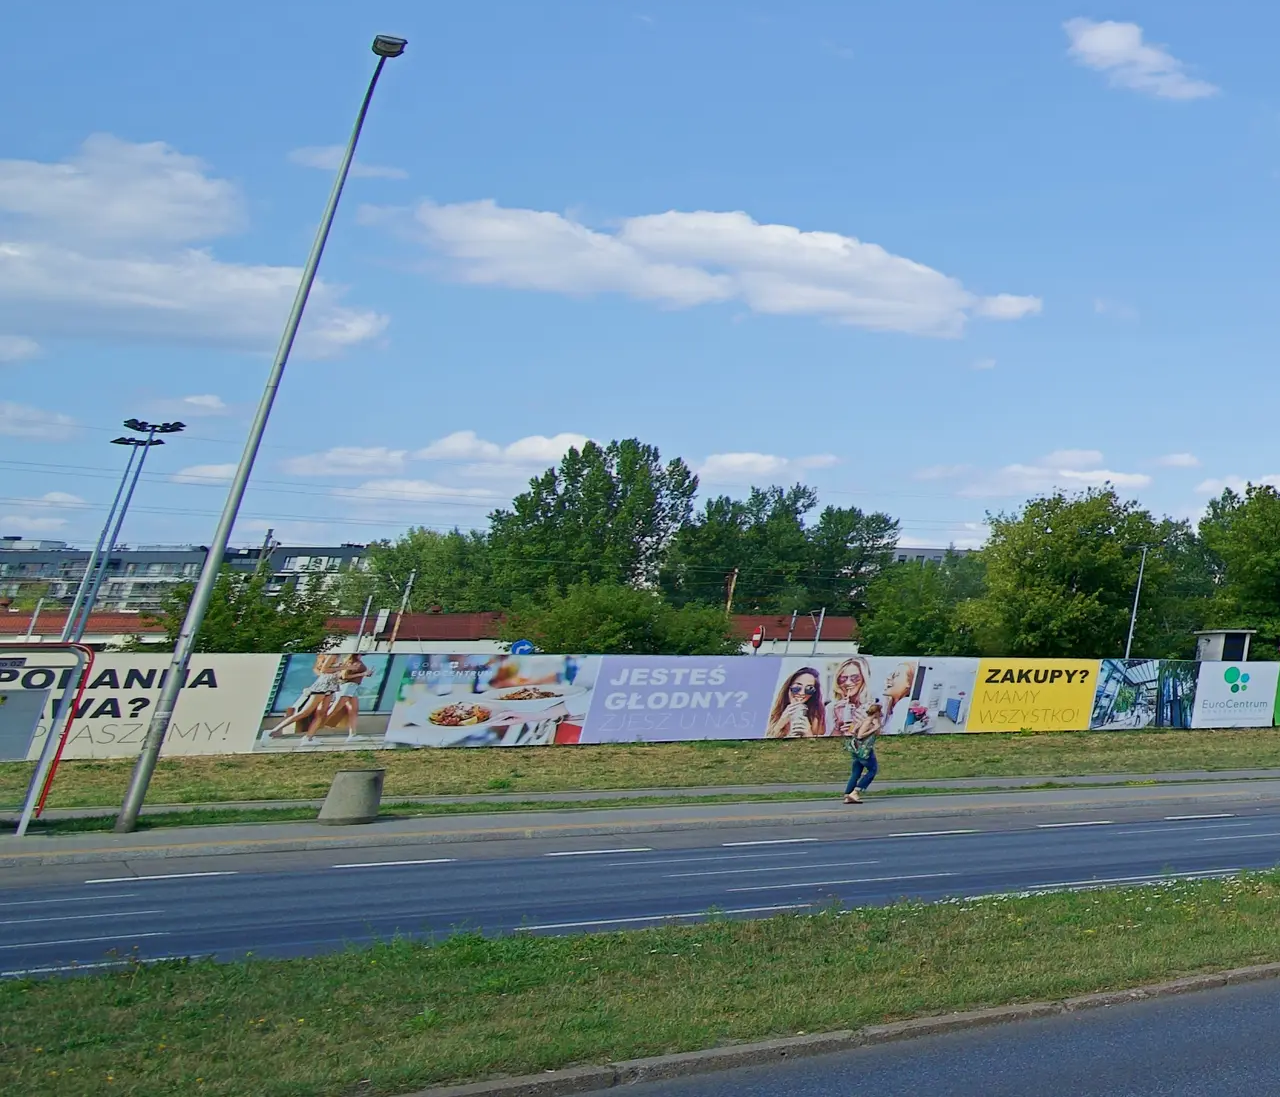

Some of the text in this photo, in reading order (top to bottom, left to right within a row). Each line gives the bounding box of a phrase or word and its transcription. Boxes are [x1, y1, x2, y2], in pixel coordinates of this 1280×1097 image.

[609, 665, 727, 686] JESTEŚ
[984, 668, 1090, 684] ZAKUPY?
[604, 690, 749, 710] GŁODNY?
[982, 689, 1041, 704] MAMY
[1201, 699, 1268, 709] EuroCentrum
[600, 710, 758, 732] ZJESZ U NAS!
[979, 708, 1081, 724] WSZYSTKO!
